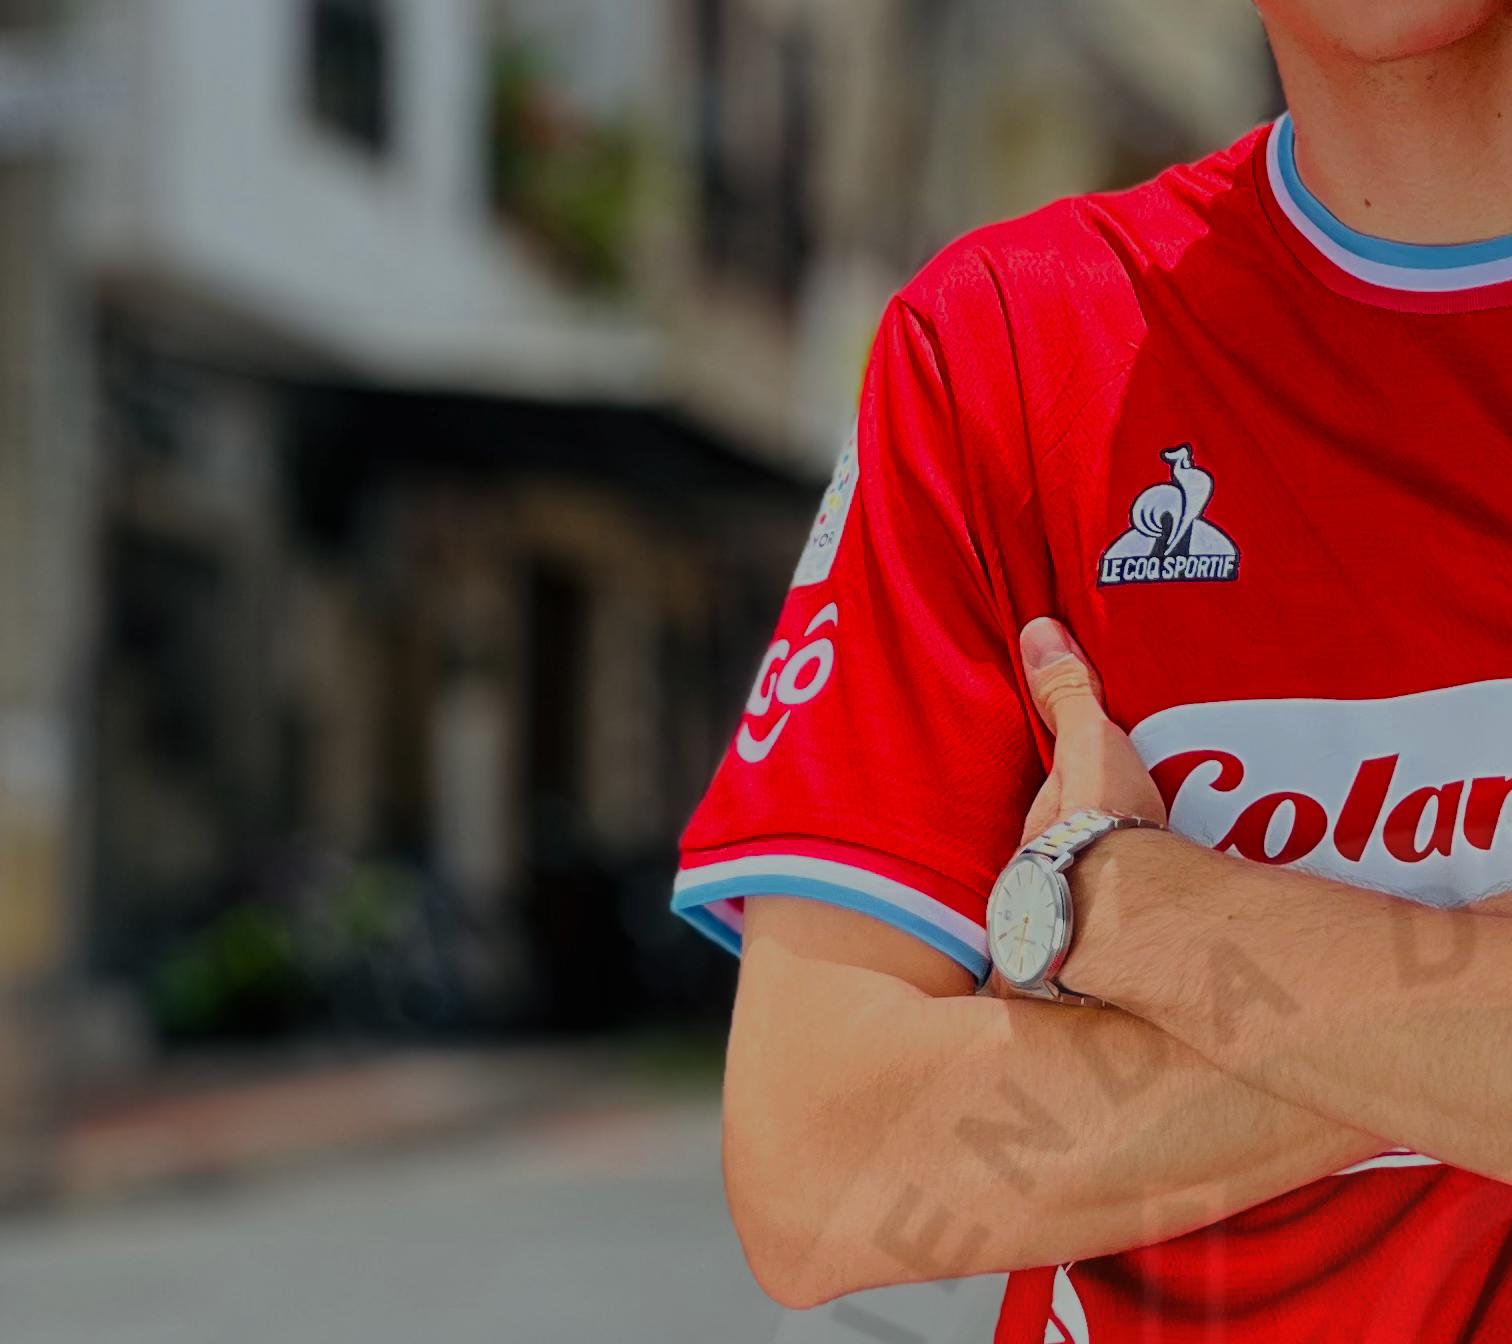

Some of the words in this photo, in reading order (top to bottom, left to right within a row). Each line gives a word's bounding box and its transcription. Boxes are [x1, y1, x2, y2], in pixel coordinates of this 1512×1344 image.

[1101, 558, 1121, 582] LE
[1123, 557, 1159, 581] COQ
[1162, 556, 1234, 579] SPORTIF
